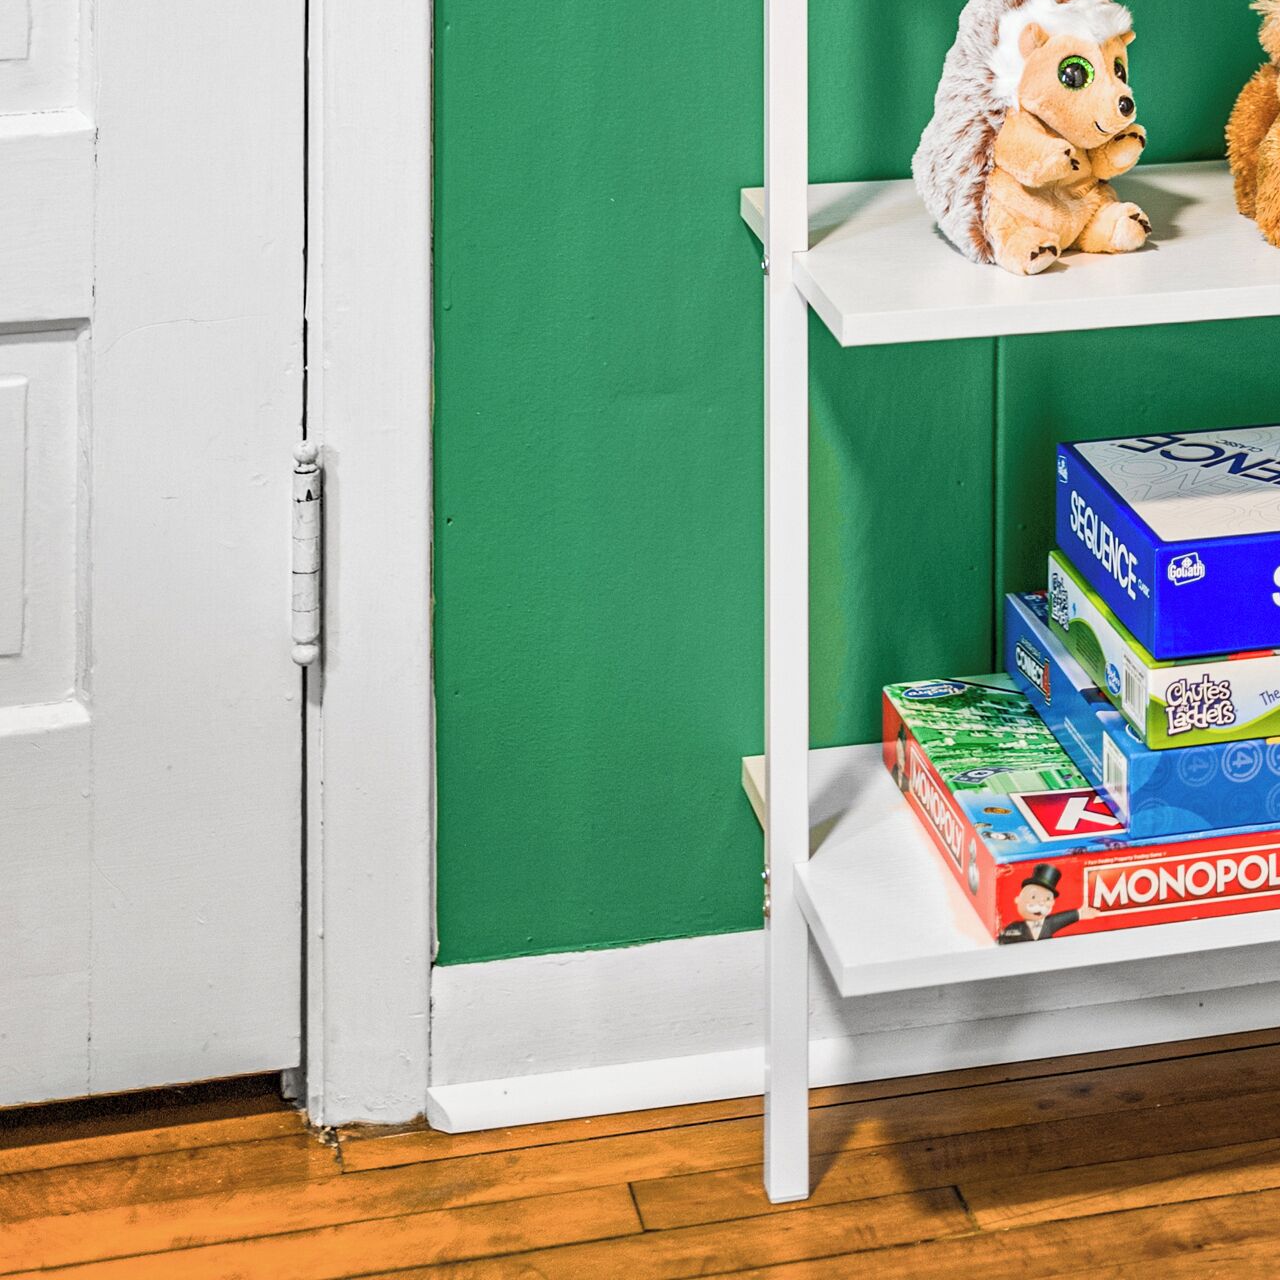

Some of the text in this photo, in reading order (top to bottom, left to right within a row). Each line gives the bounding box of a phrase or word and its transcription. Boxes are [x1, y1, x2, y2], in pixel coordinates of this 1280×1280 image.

[1214, 438, 1264, 454] CLASSIC
[1070, 490, 1138, 601] SEQUENCE
[1170, 560, 1204, 579] Goliath
[1165, 674, 1230, 708] Chutes
[1259, 688, 1280, 707] The
[1166, 698, 1237, 736] Ladders
[912, 762, 963, 860] MONOPOLY
